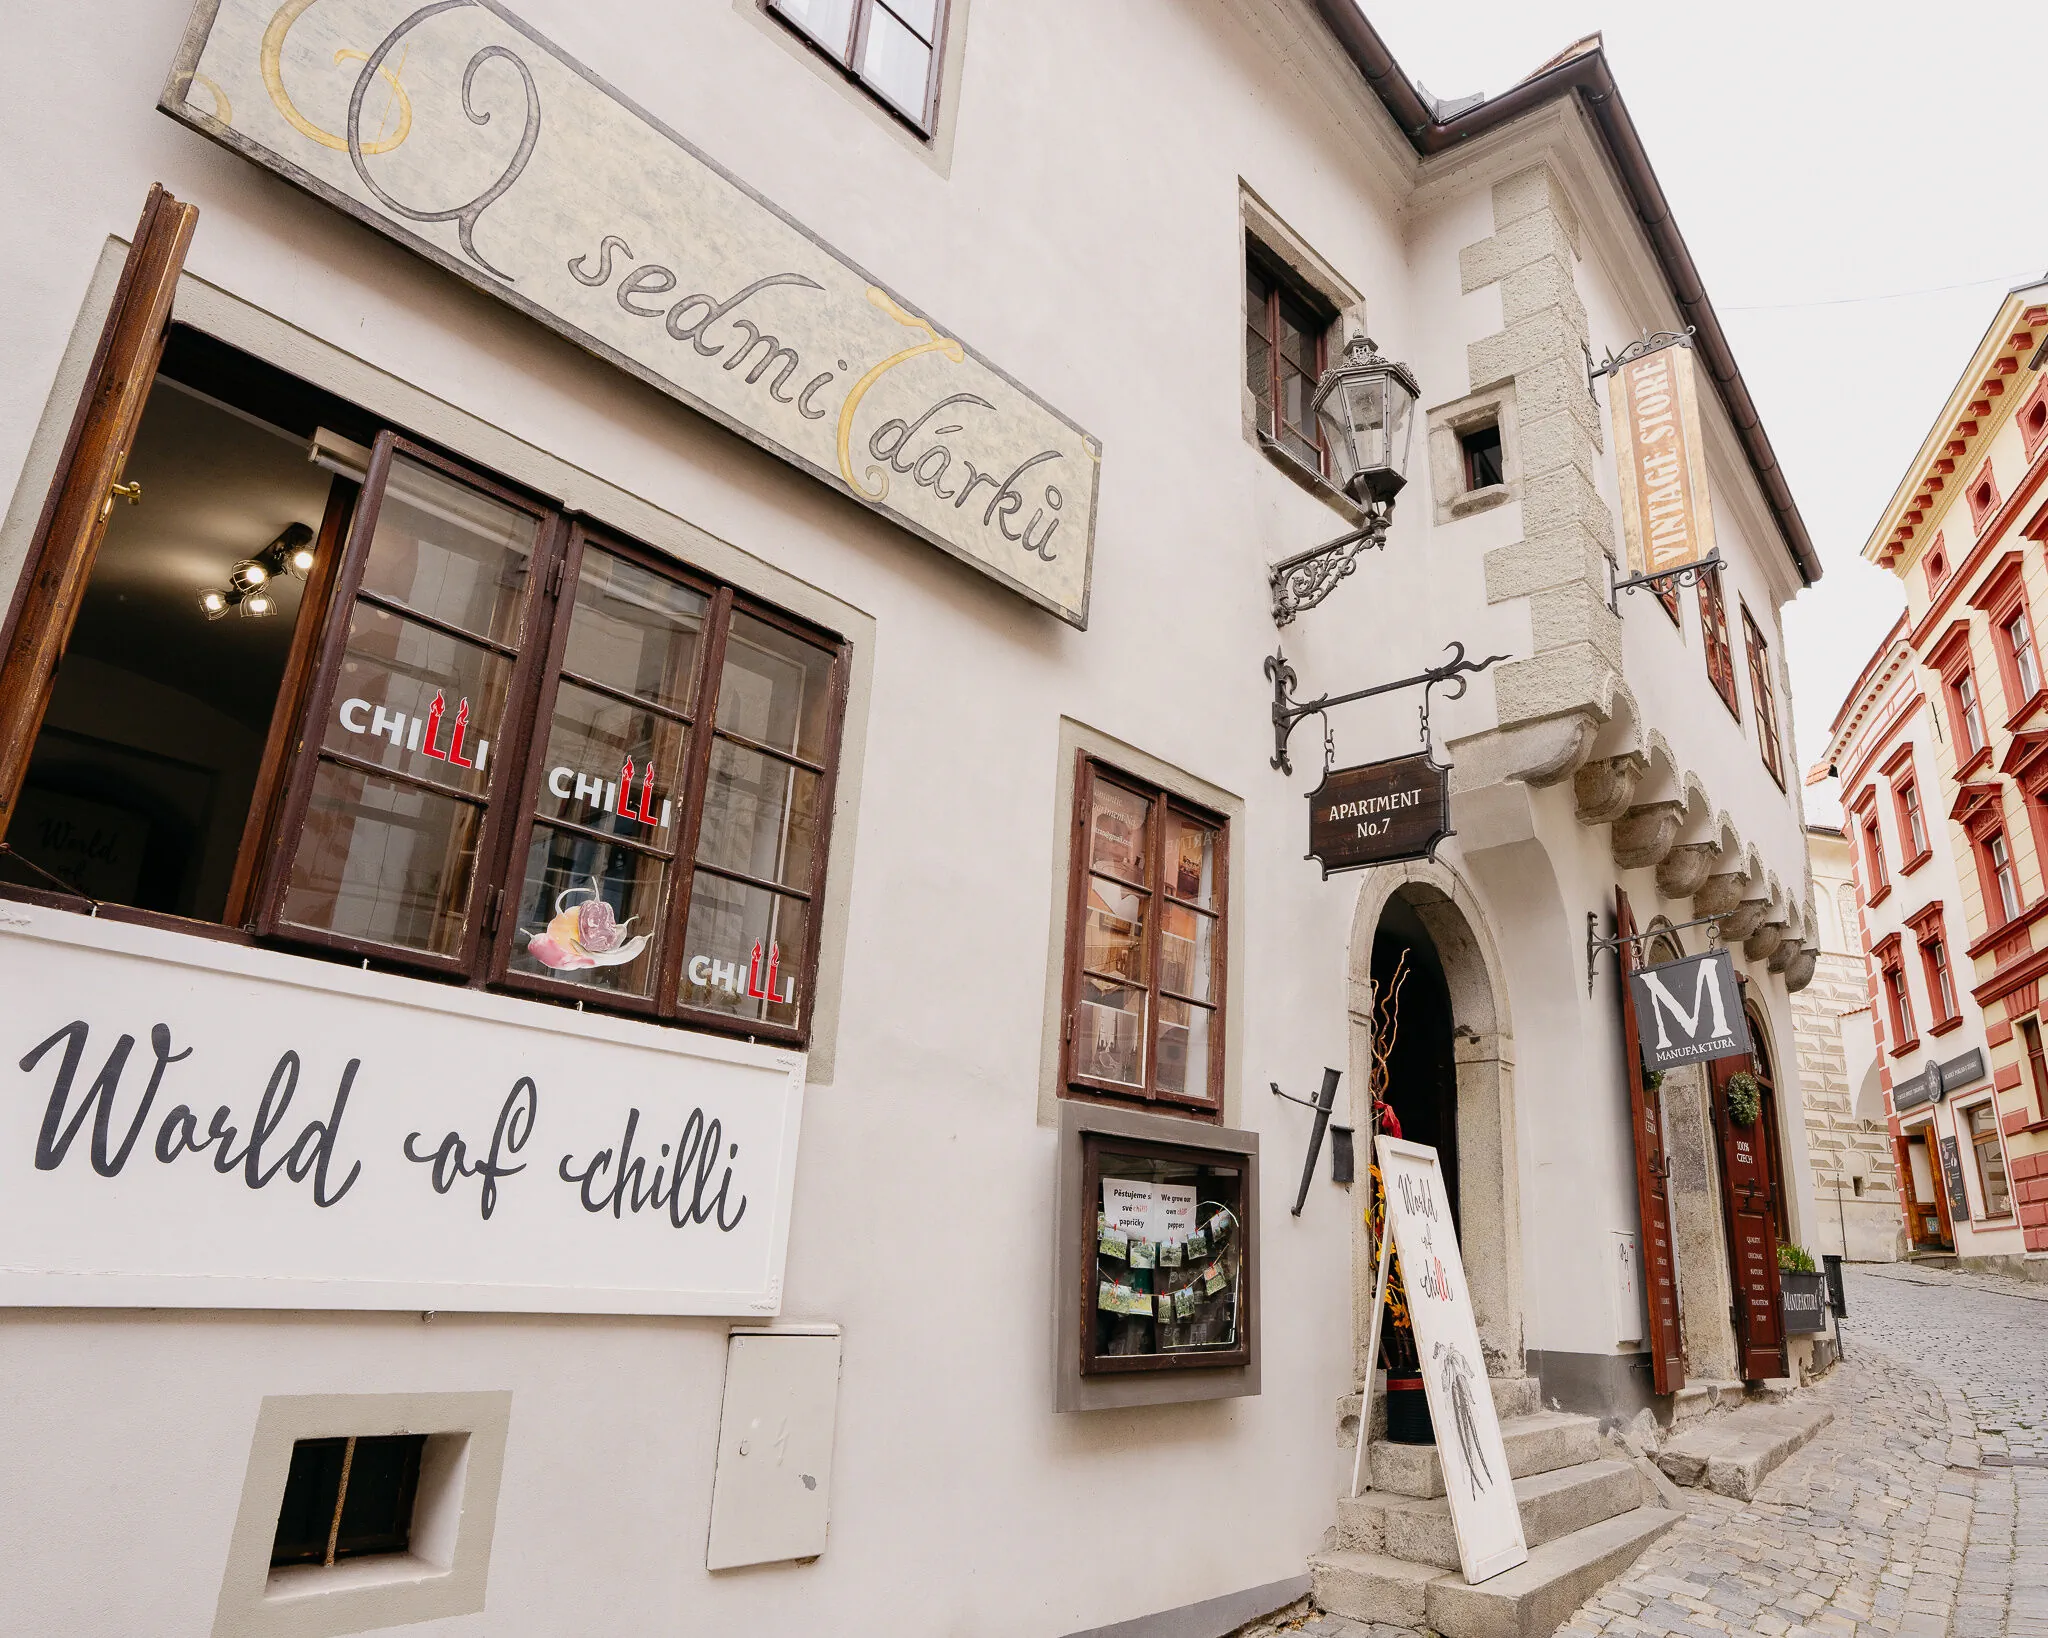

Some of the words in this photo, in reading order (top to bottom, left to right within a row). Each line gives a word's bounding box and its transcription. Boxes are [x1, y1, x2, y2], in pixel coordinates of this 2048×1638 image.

[568, 235, 847, 420] sedmi
[868, 392, 1064, 562] dárků
[1632, 357, 1676, 445] STORE
[1643, 447, 1689, 566] VINTAGE
[338, 688, 490, 772] CHILLI
[548, 755, 672, 828] CHILLI
[1329, 789, 1422, 822] APARTMENT
[1357, 818, 1391, 838] No.7
[688, 937, 794, 1003] CHILLI
[1639, 958, 1733, 1049] M
[1656, 1037, 1736, 1061] MANUFAKTURA
[19, 1020, 362, 1208] World
[403, 1075, 537, 1221] of
[558, 1107, 748, 1232] chilli
[1736, 1140, 1750, 1152] 100%
[1736, 1152, 1753, 1164] CZECH
[1113, 1189, 1147, 1200] Pěstujeme
[1161, 1194, 1171, 1202] We
[1171, 1196, 1183, 1204] grow
[1398, 1174, 1438, 1223] World
[1167, 1221, 1185, 1230] peppers
[1420, 1256, 1454, 1302] chilli
